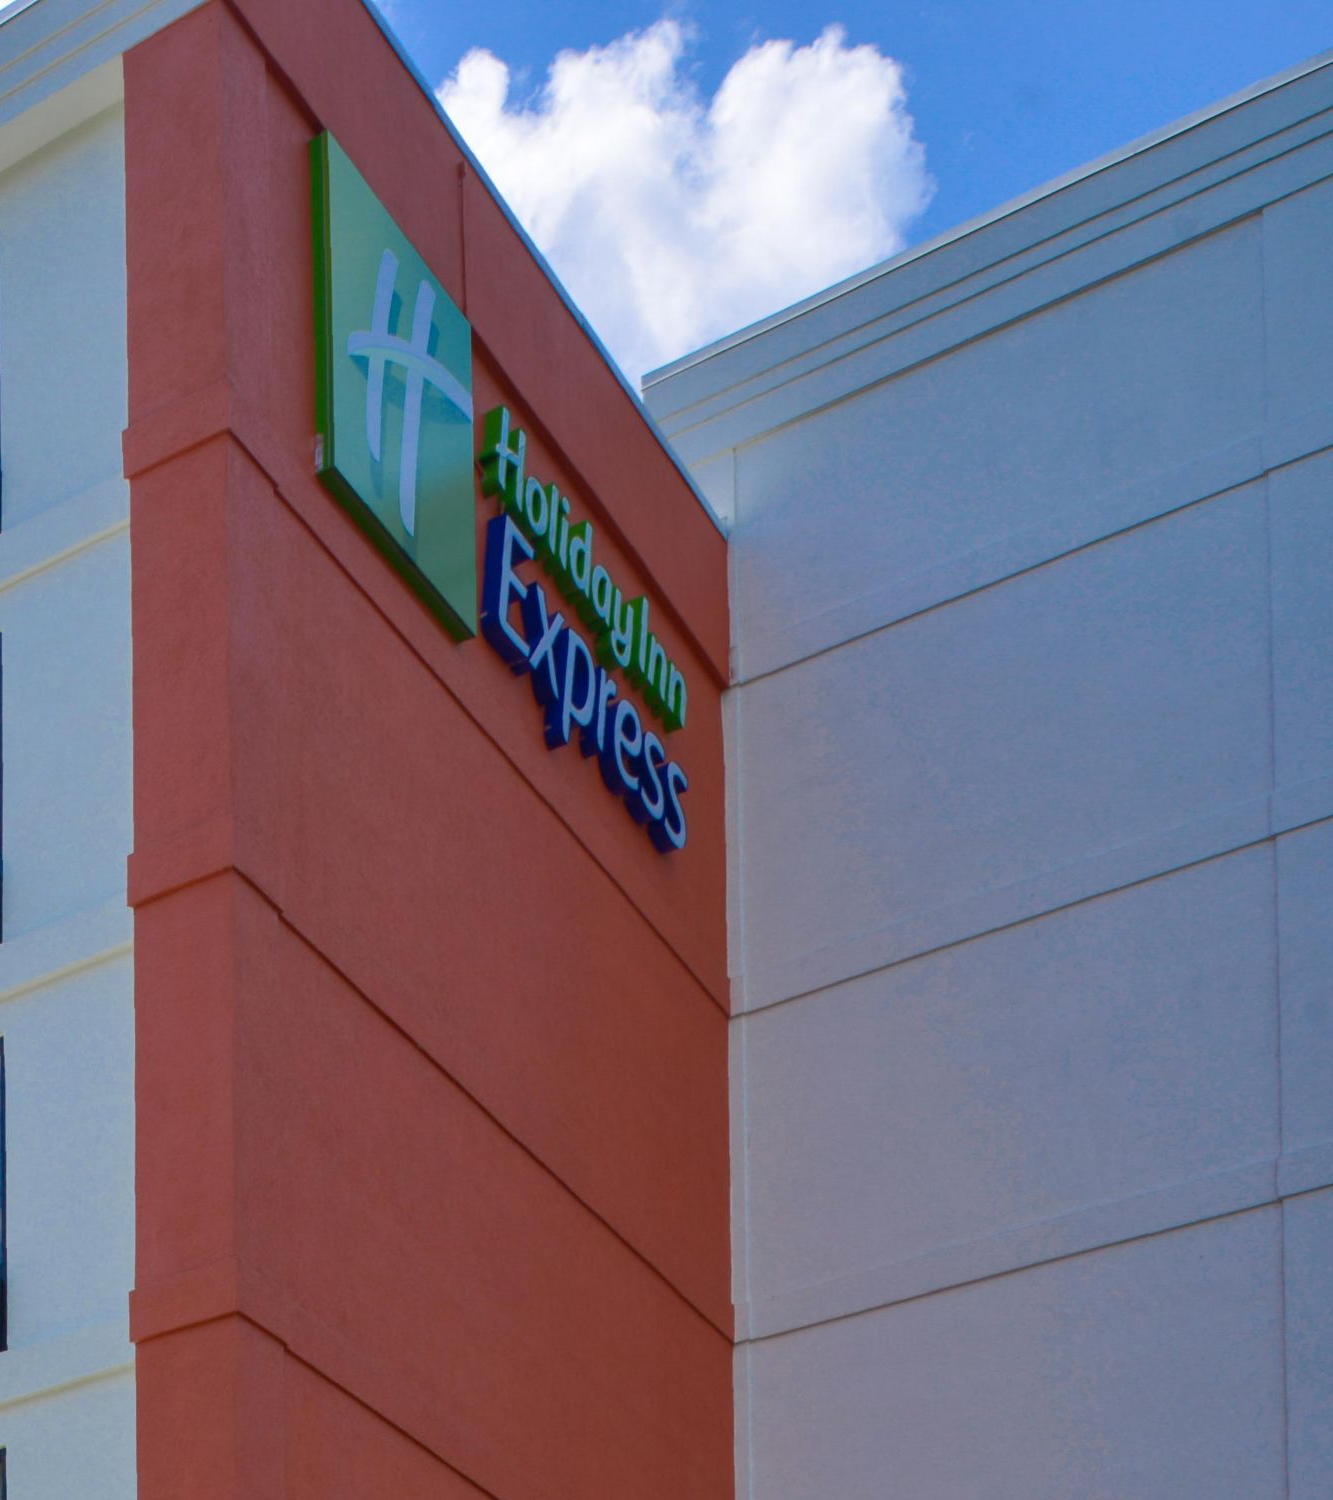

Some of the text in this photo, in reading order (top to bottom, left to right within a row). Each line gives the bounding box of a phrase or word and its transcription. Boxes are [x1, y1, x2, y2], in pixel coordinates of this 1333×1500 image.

[492, 404, 687, 729] Holiday Inn
[497, 512, 688, 850] Express
